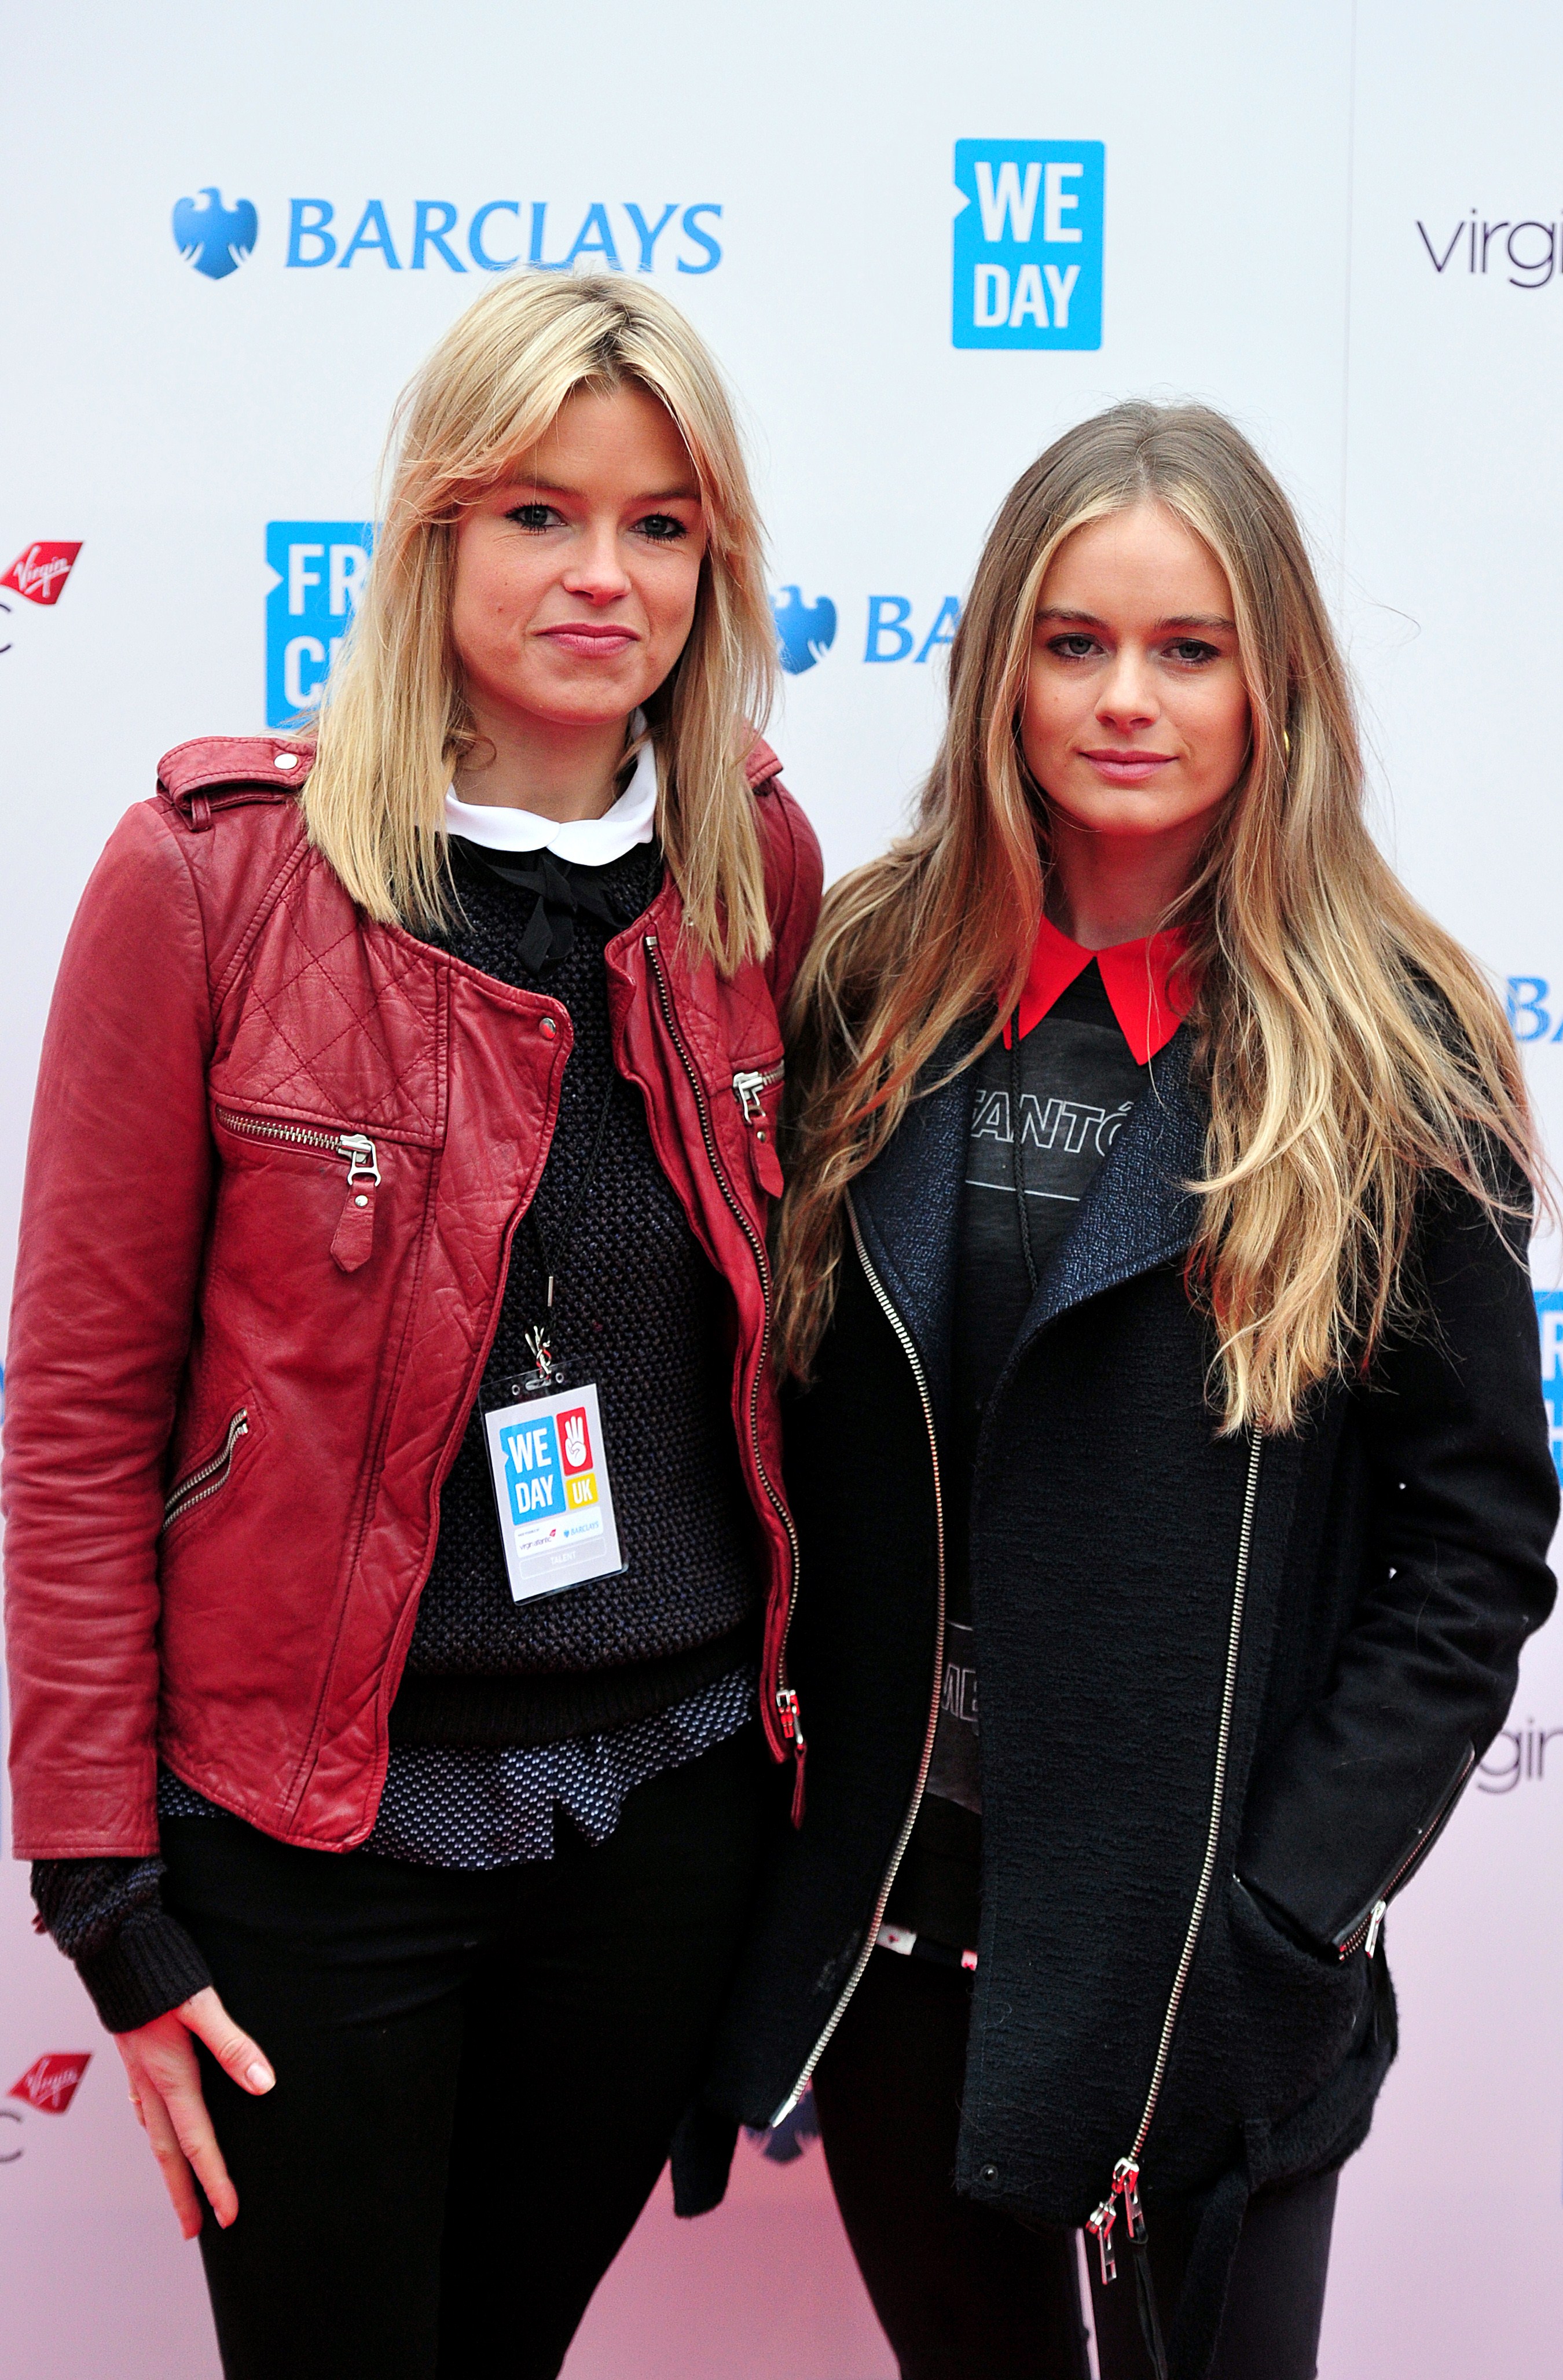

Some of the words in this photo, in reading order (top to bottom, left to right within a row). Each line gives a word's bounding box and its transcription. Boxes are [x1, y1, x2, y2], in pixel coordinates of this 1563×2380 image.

[974, 161, 1084, 243] WE
[284, 198, 724, 274] BARCLAYS
[974, 263, 1081, 328] DAY
[13, 545, 73, 598] Virgin
[284, 636, 344, 711] C
[1507, 977, 1563, 1042] B
[508, 1427, 552, 1474] WE
[515, 1474, 553, 1514] DAY
[572, 1478, 593, 1504] UK
[571, 1521, 599, 1536] BARCLAYS
[550, 1551, 577, 1565] TALENT
